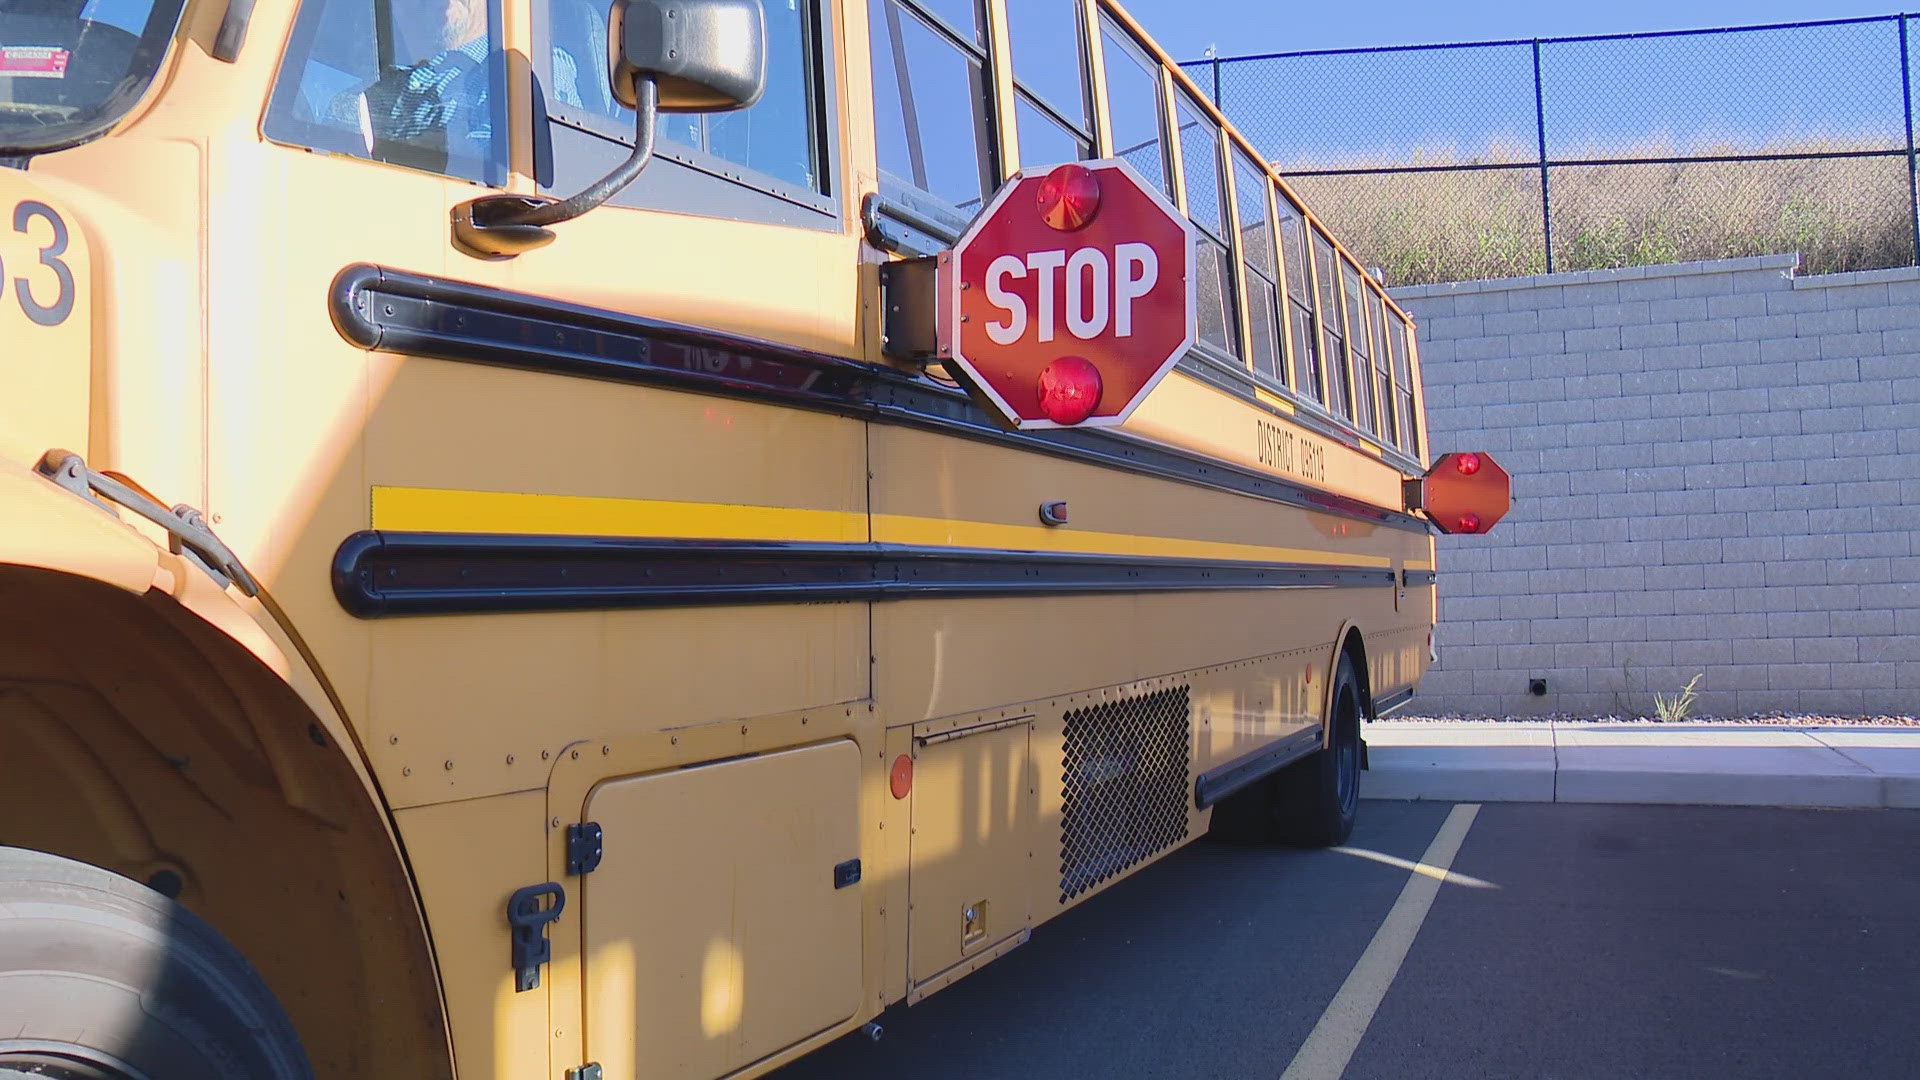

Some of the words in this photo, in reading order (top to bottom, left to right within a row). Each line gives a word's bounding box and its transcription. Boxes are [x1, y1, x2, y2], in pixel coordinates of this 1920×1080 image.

[0, 200, 75, 326] 3
[985, 242, 1158, 345] STOP
[1257, 419, 1294, 473] DISTRICT
